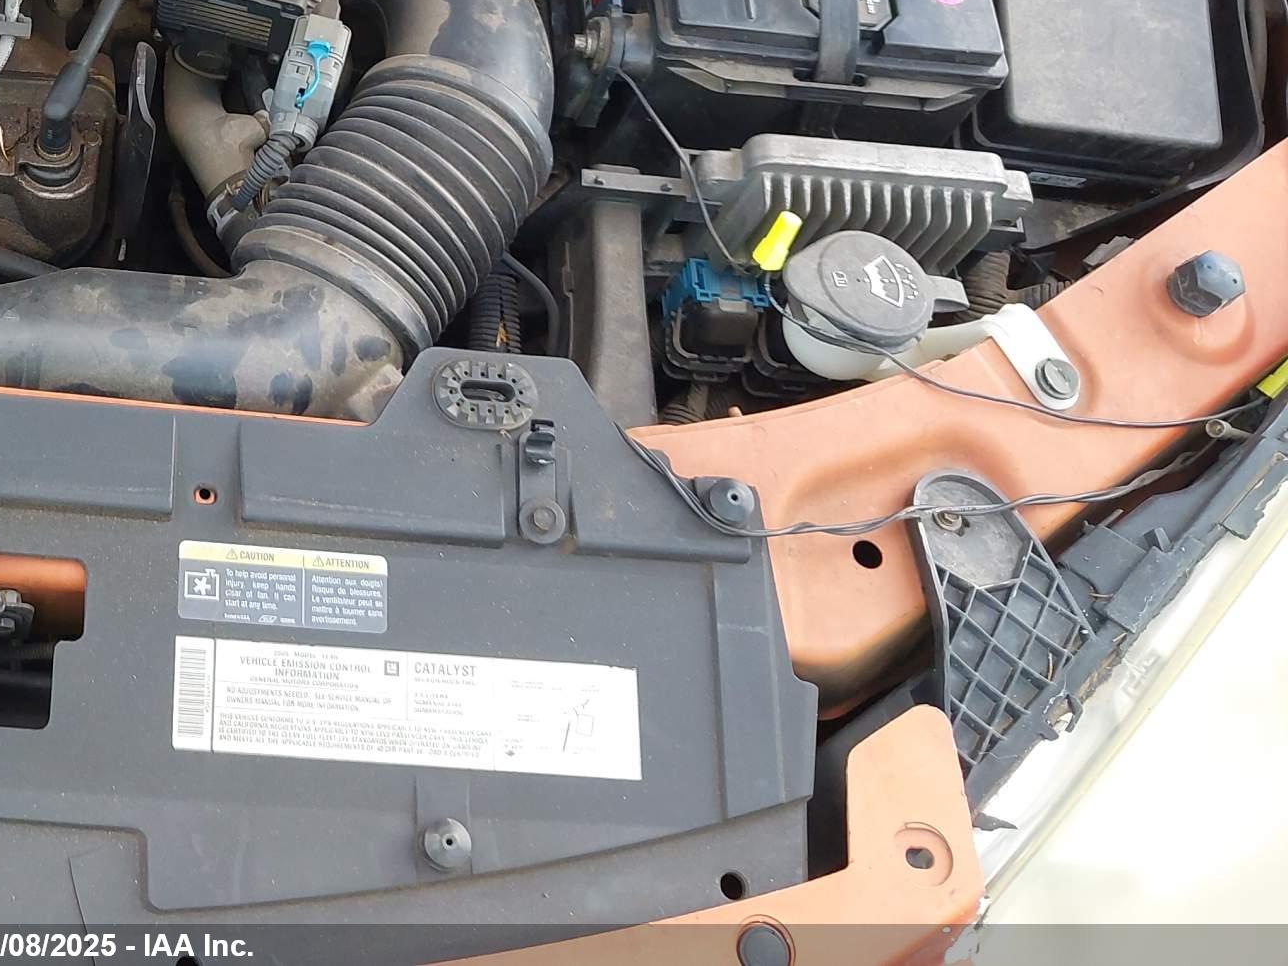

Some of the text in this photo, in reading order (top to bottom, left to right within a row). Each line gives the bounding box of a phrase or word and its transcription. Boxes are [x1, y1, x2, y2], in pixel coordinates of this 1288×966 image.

[239, 550, 274, 561] CAUTION
[325, 557, 369, 569] ATTENTION
[226, 568, 295, 581] To help avoid personal
[252, 580, 268, 589] keep
[275, 582, 295, 591] hands
[311, 575, 340, 584] Attention
[344, 577, 356, 586] aux
[311, 584, 333, 594] Risque
[337, 586, 346, 595] de
[283, 593, 295, 601] can
[358, 598, 372, 606] peut
[225, 599, 239, 607] start
[248, 601, 260, 609] any
[311, 605, 332, 613] mettre
[342, 607, 365, 615] tourner
[368, 609, 382, 617] sans
[239, 655, 370, 673] VEHICLE EMISSION CONTROL
[414, 661, 477, 677] CATALYST
[274, 667, 339, 680] INFORMATION
